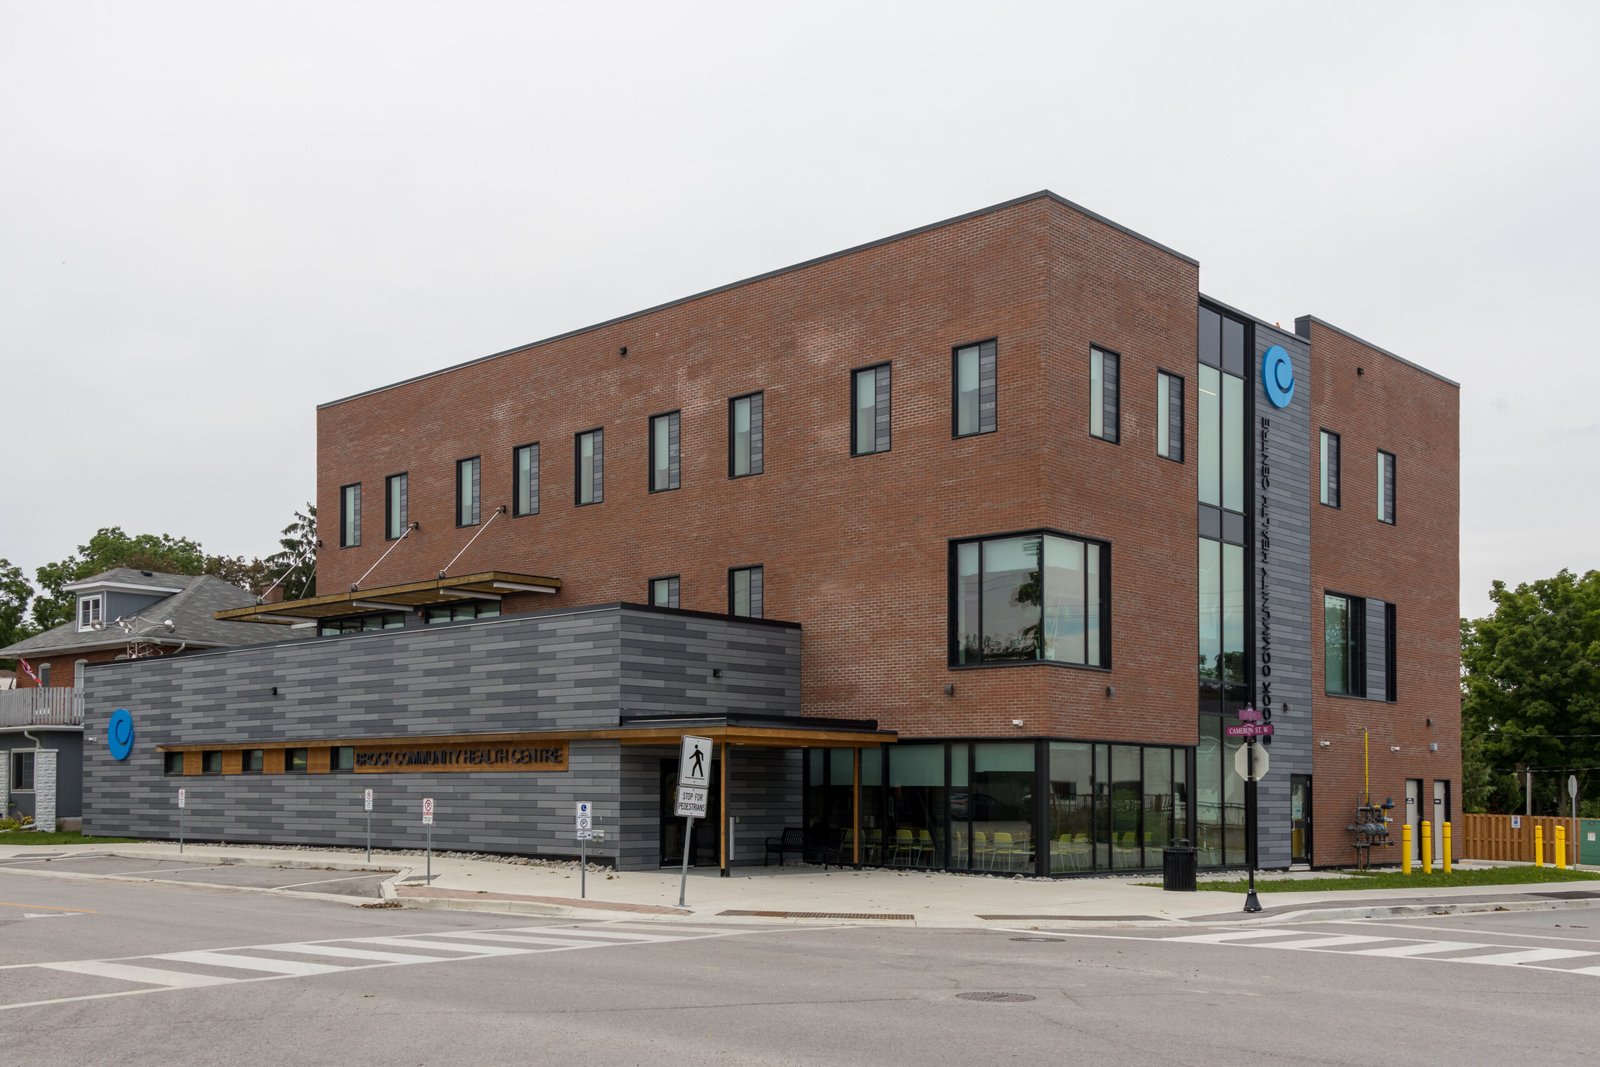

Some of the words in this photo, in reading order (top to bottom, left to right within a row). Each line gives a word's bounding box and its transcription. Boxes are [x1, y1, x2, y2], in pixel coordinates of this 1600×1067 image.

[1261, 417, 1270, 490] CENTRE
[1261, 495, 1270, 564] HEALTH
[1261, 567, 1271, 677] COMMUNITY
[356, 752, 393, 766] BROCK
[394, 750, 462, 765] COMMUNITY
[463, 748, 509, 764] HEALTH
[511, 747, 563, 764] CENTRE
[679, 802, 705, 811] PEDESTRIANS
[683, 792, 693, 800] STOP
[695, 793, 703, 801] FOR
